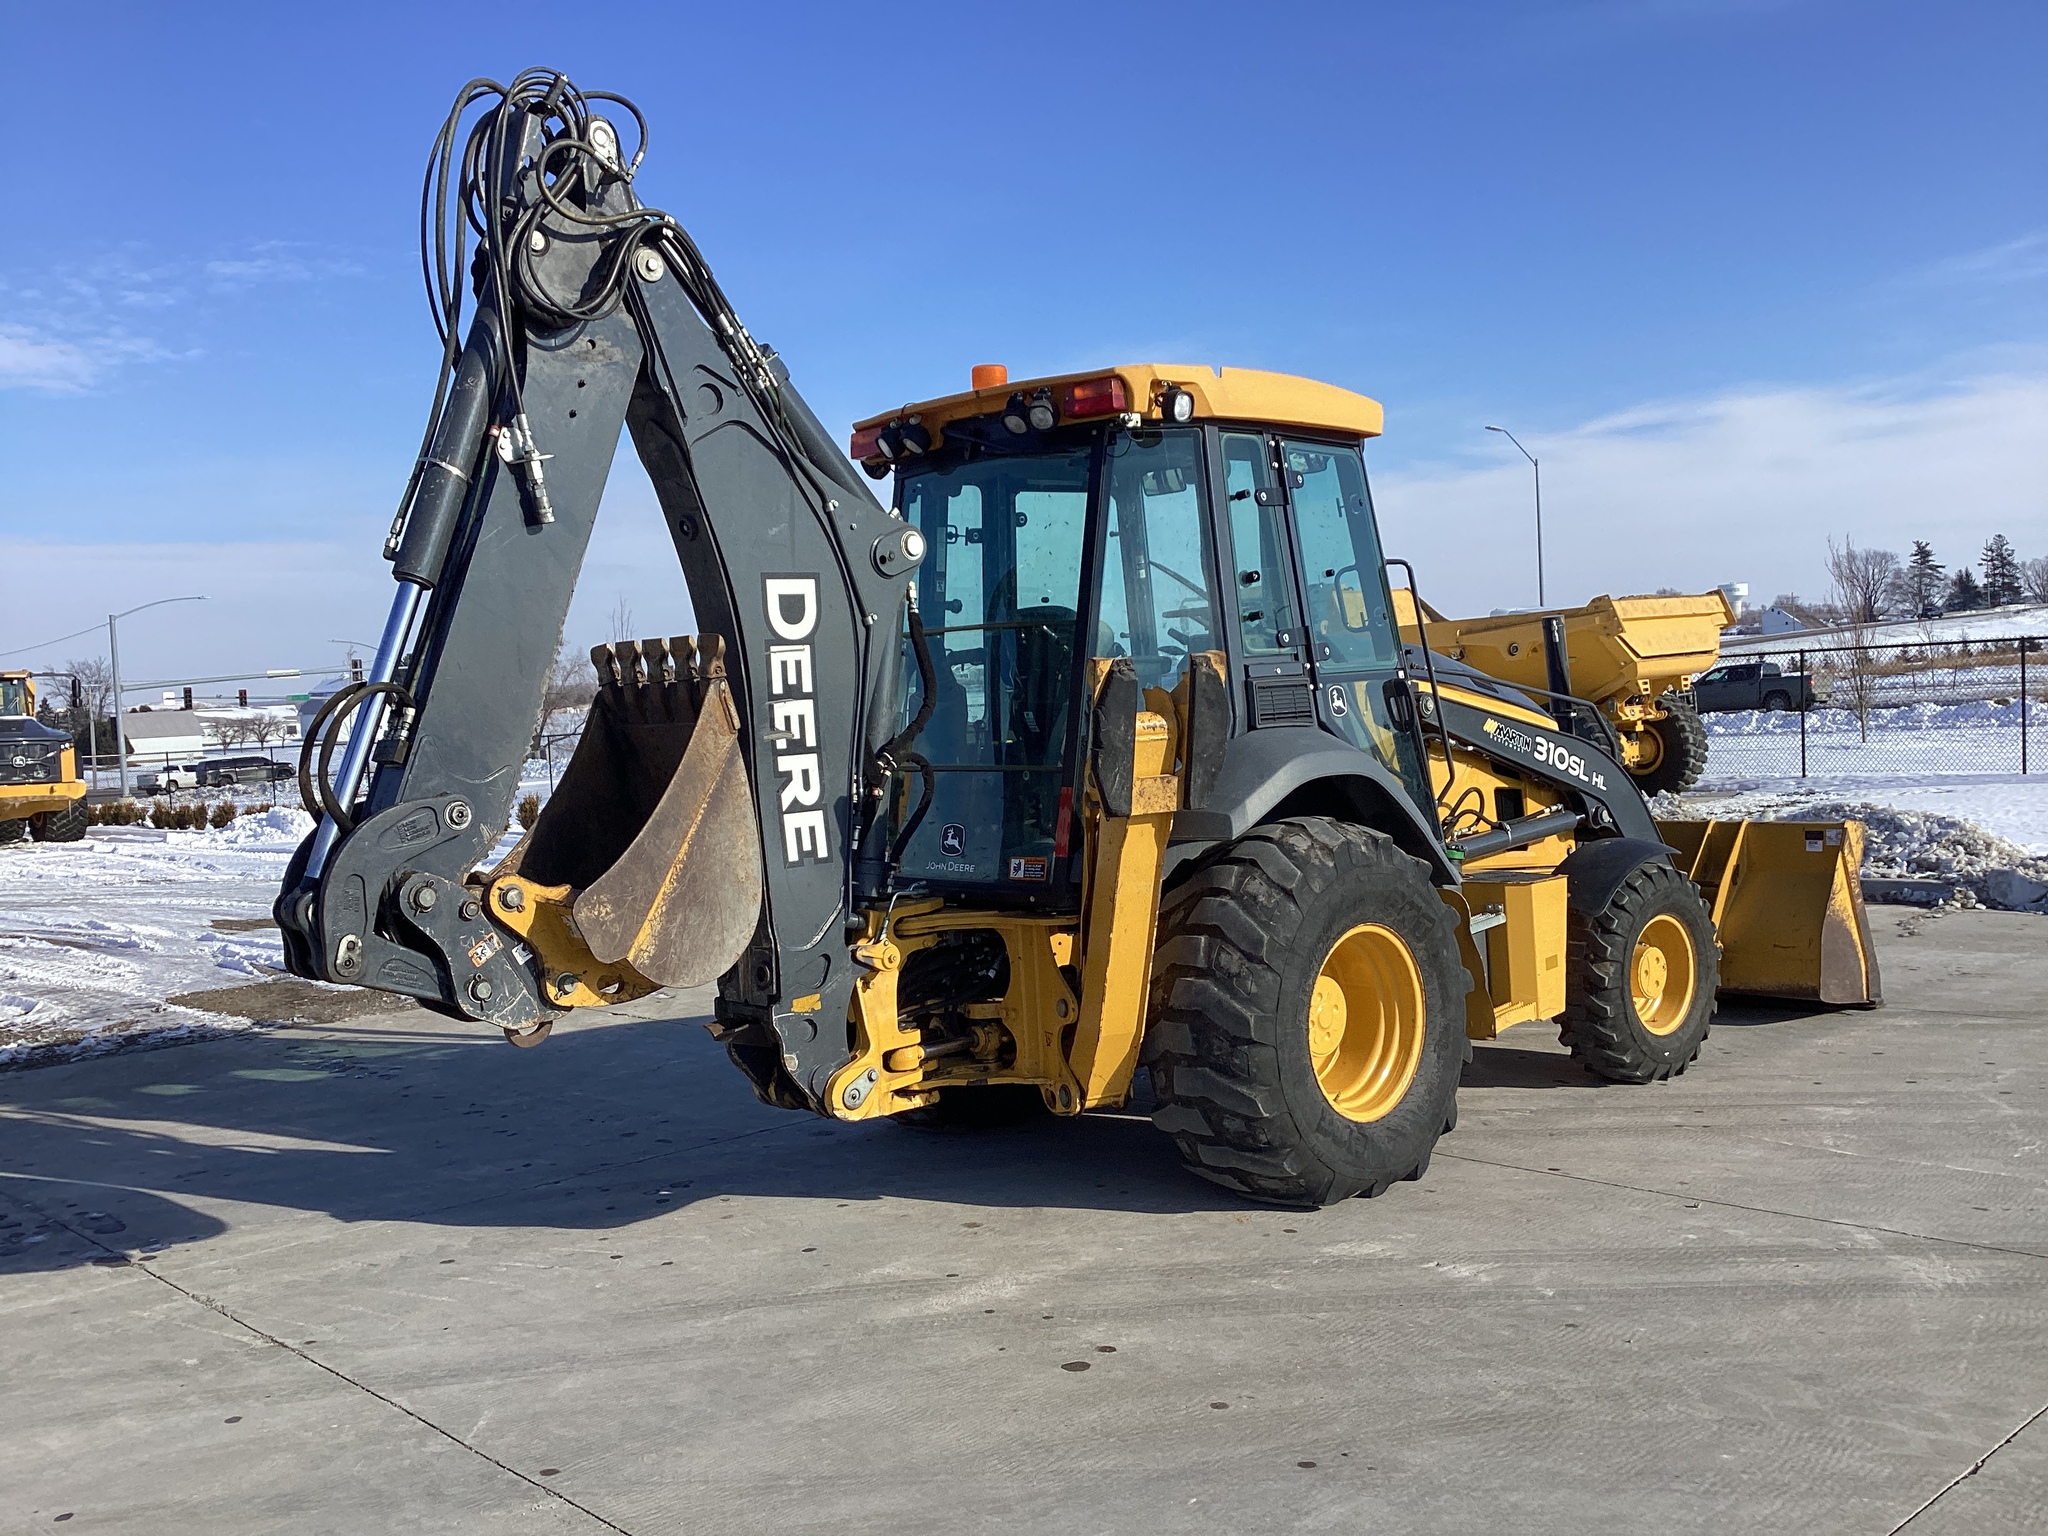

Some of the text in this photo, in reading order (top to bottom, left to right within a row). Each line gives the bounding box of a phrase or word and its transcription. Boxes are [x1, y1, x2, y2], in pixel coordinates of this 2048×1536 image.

[765, 578, 828, 862] DEERE
[1493, 722, 1532, 752] MARTIN
[1533, 736, 1607, 791] 310SL HL
[926, 861, 976, 872] JOHN DEERE
